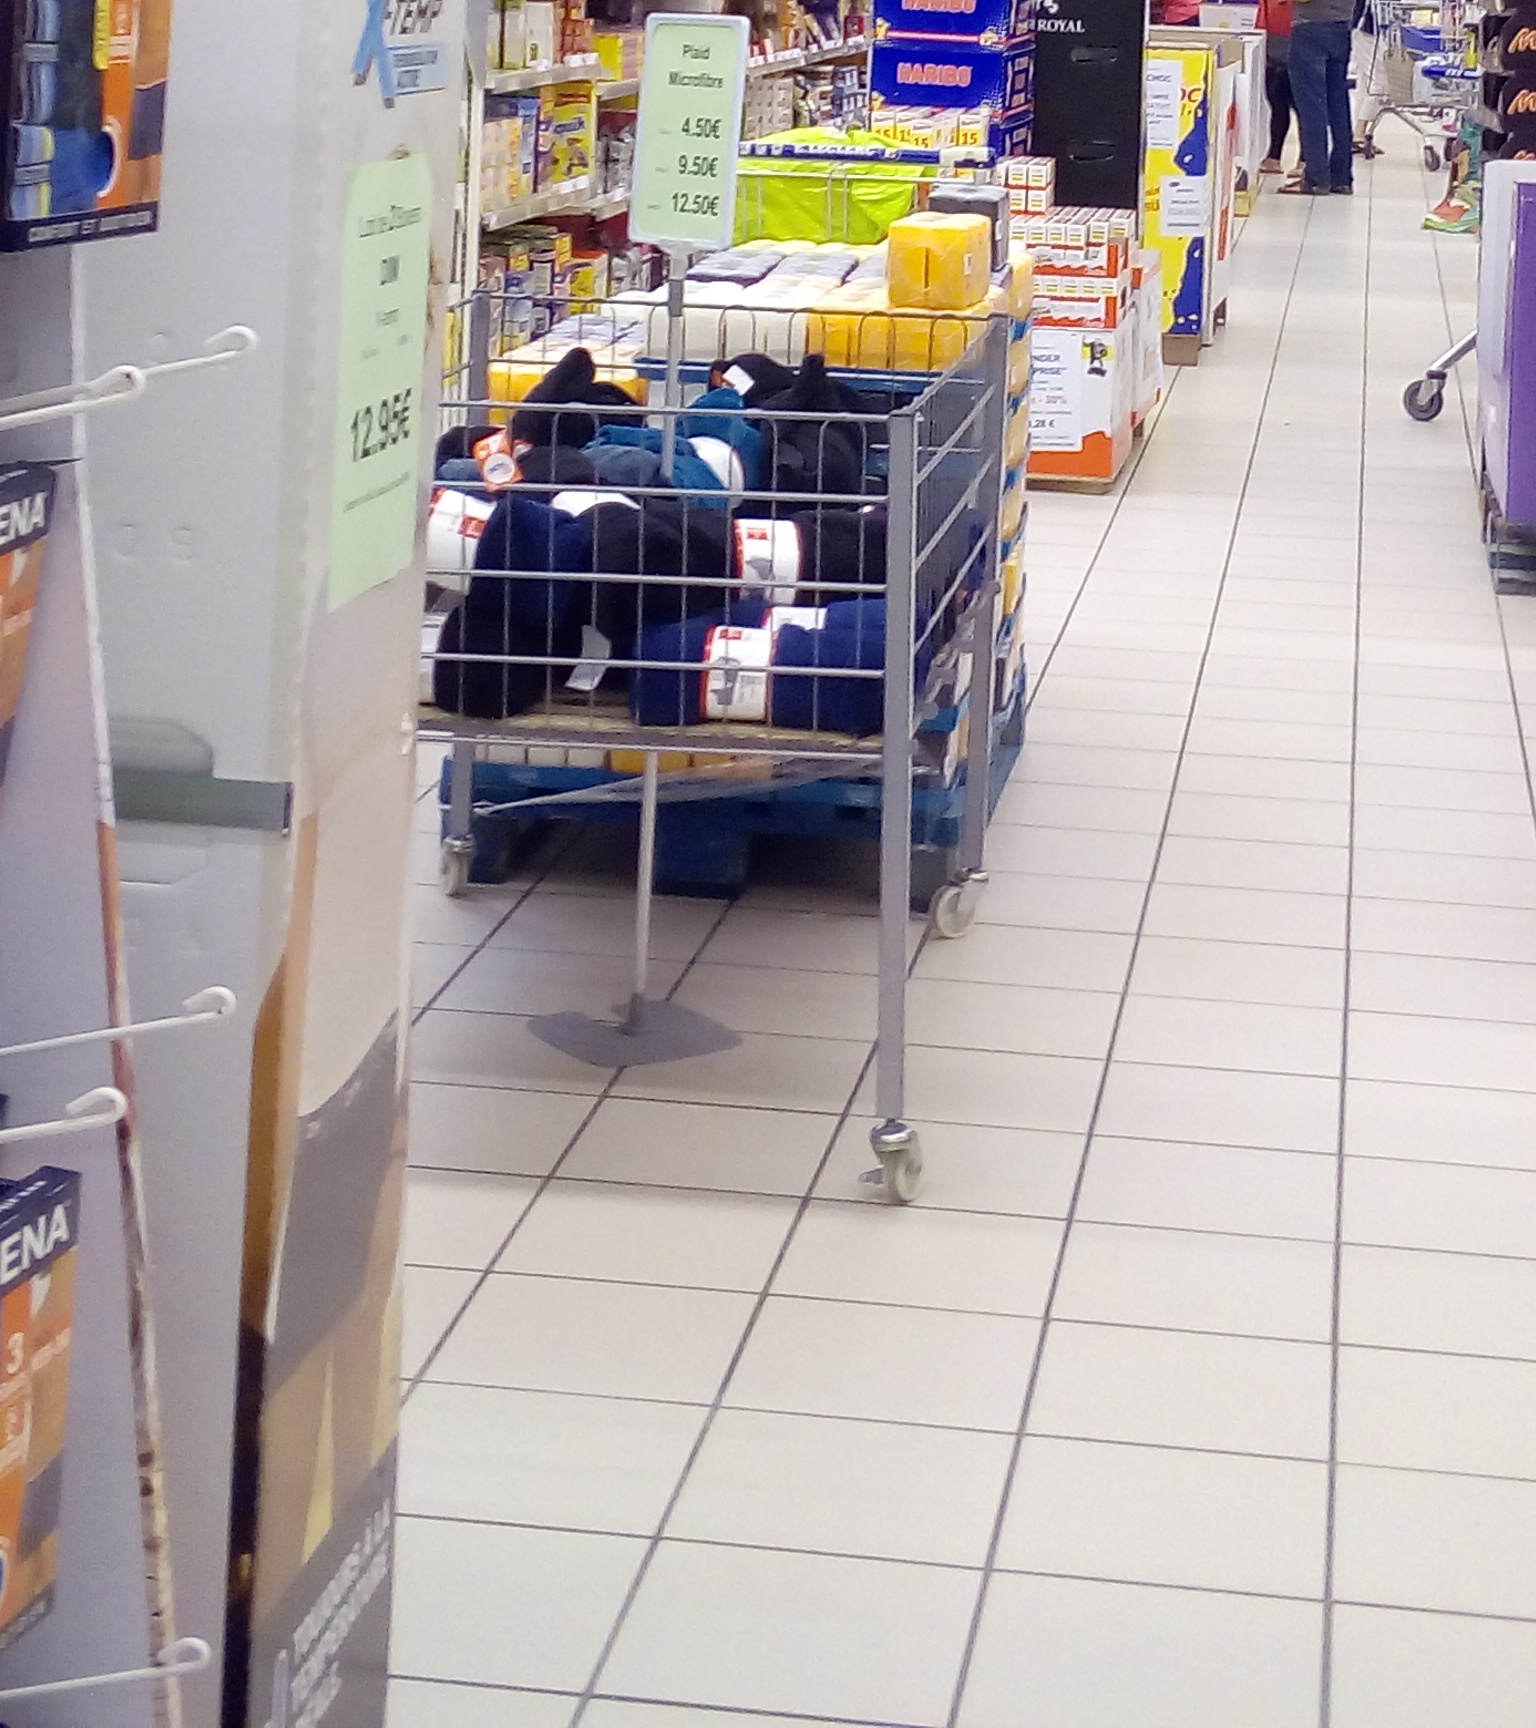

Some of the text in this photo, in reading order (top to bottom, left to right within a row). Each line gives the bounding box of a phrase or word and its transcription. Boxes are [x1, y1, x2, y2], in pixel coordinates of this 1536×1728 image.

[1037, 18, 1086, 34] ROYAL
[682, 44, 711, 60] Plaid
[668, 71, 724, 89] Microfibre
[896, 62, 973, 87] HARIBO
[681, 116, 722, 140] 4.50€
[960, 132, 978, 146] 15
[677, 154, 719, 179] 9.50€
[671, 191, 720, 218] 12.50€
[350, 387, 412, 463] 12.95€
[6, 1331, 25, 1374] 3
